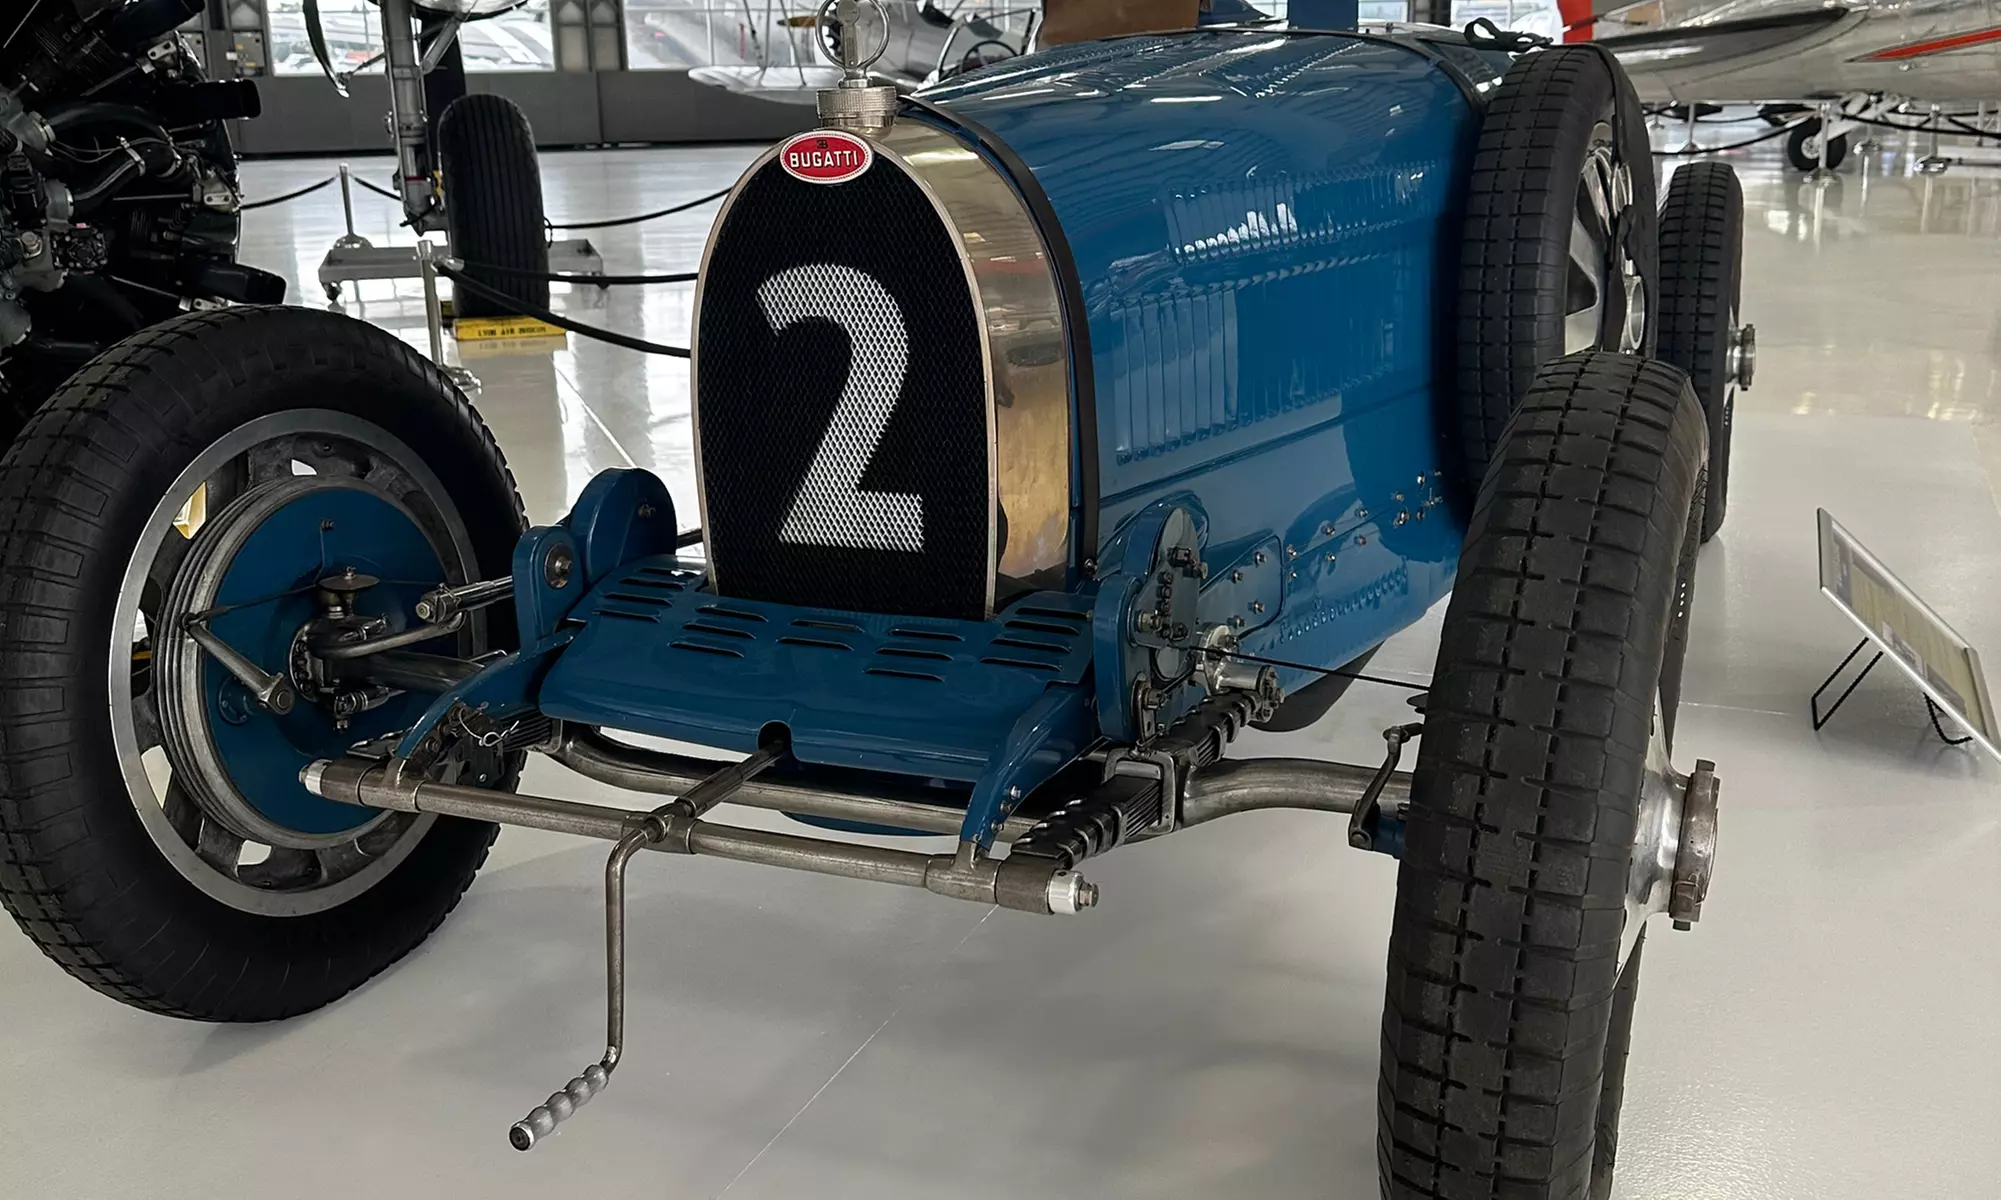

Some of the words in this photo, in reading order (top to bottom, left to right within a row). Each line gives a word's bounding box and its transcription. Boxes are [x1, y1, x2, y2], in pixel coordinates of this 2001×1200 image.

[789, 150, 859, 168] BUGATTI
[501, 328, 515, 336] AIR
[757, 264, 924, 552] 2
